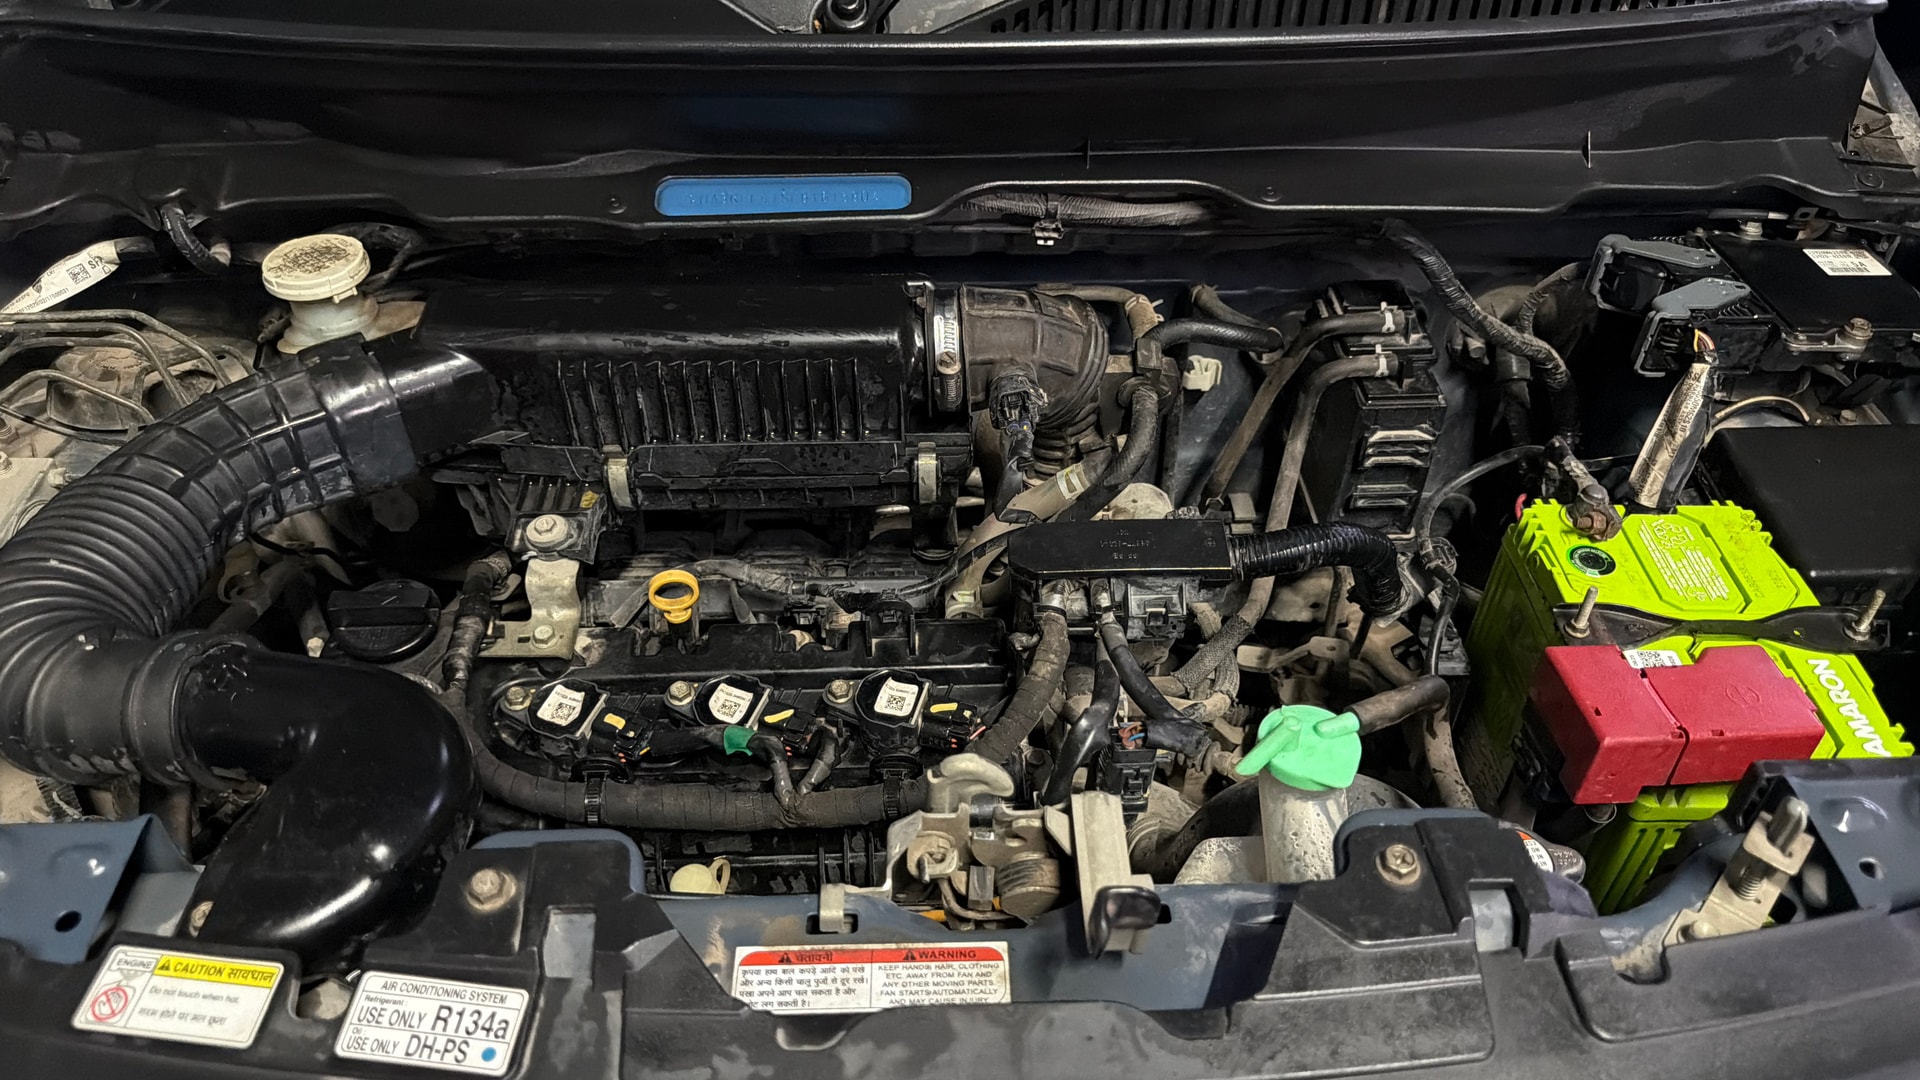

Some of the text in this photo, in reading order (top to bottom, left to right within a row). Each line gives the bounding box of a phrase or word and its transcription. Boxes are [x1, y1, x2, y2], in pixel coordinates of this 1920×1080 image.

[1806, 659, 1892, 757] AMARON
[795, 951, 833, 962] चेतावनी
[918, 950, 977, 959] WARNING
[116, 959, 154, 970] ENGINE
[173, 961, 225, 977] CAUTION
[228, 967, 275, 982] सावधान
[149, 986, 161, 994] Do
[163, 988, 176, 996] not
[177, 989, 201, 999] touch
[201, 992, 224, 1001] when
[364, 994, 404, 1005] Refrigerant
[380, 980, 508, 1004] AIR CONDITIONING SYSTEM
[932, 988, 998, 996] AUTOMATICALLY
[357, 1004, 510, 1040] USE ONLY R134a
[352, 1026, 362, 1035] Oil
[346, 1033, 470, 1063] USE ONLY DH-PS
